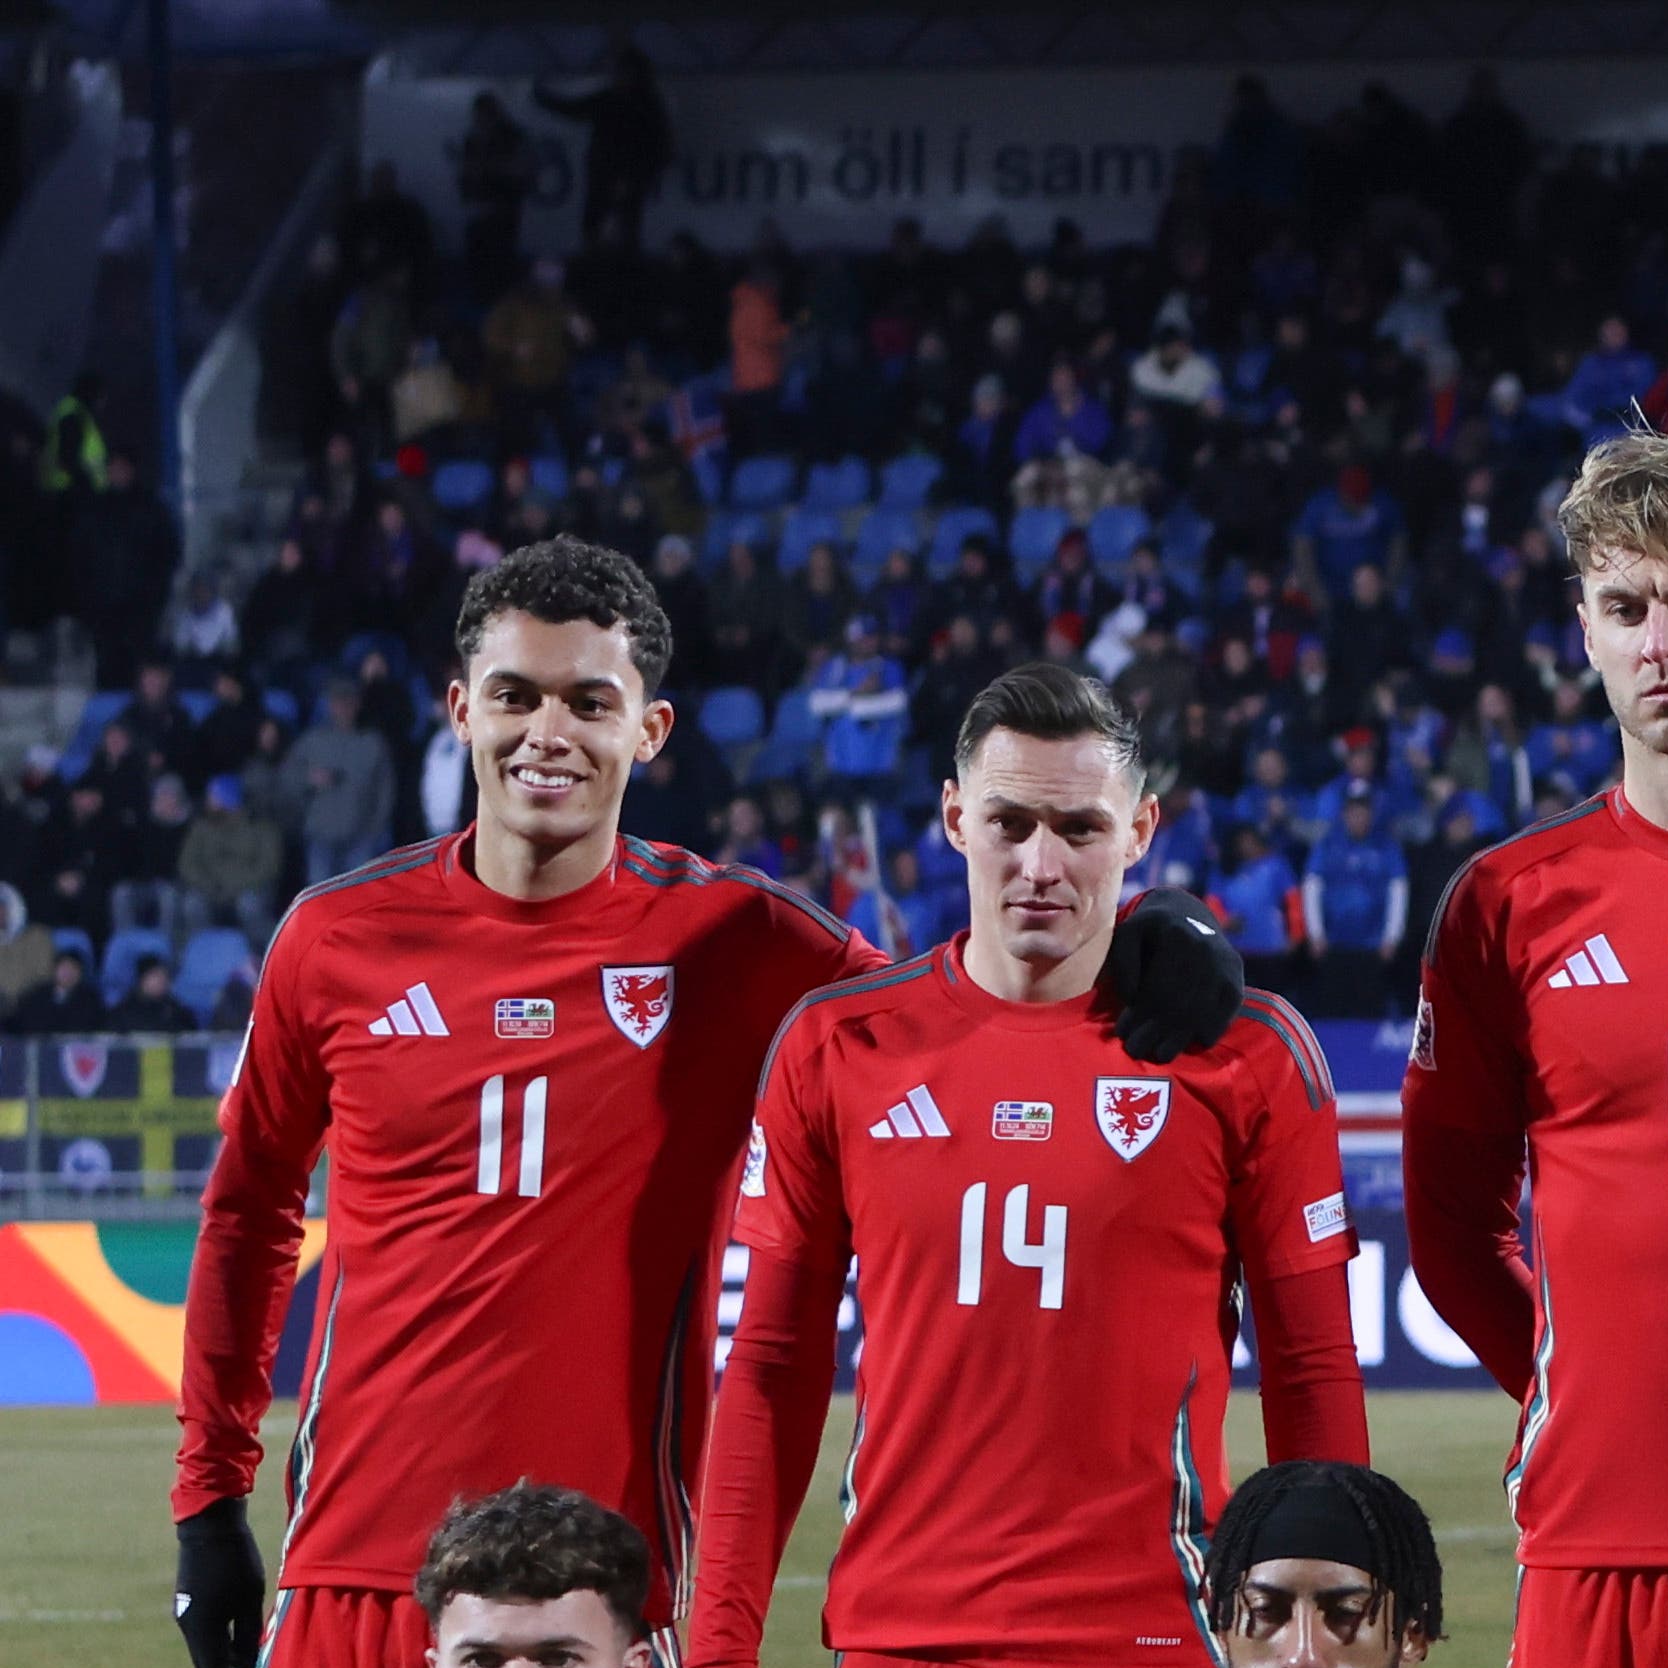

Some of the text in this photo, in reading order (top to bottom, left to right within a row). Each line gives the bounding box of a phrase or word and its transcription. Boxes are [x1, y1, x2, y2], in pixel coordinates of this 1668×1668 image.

[835, 124, 924, 200] öll
[477, 1075, 548, 1197] 11
[957, 1182, 1068, 1310] 14
